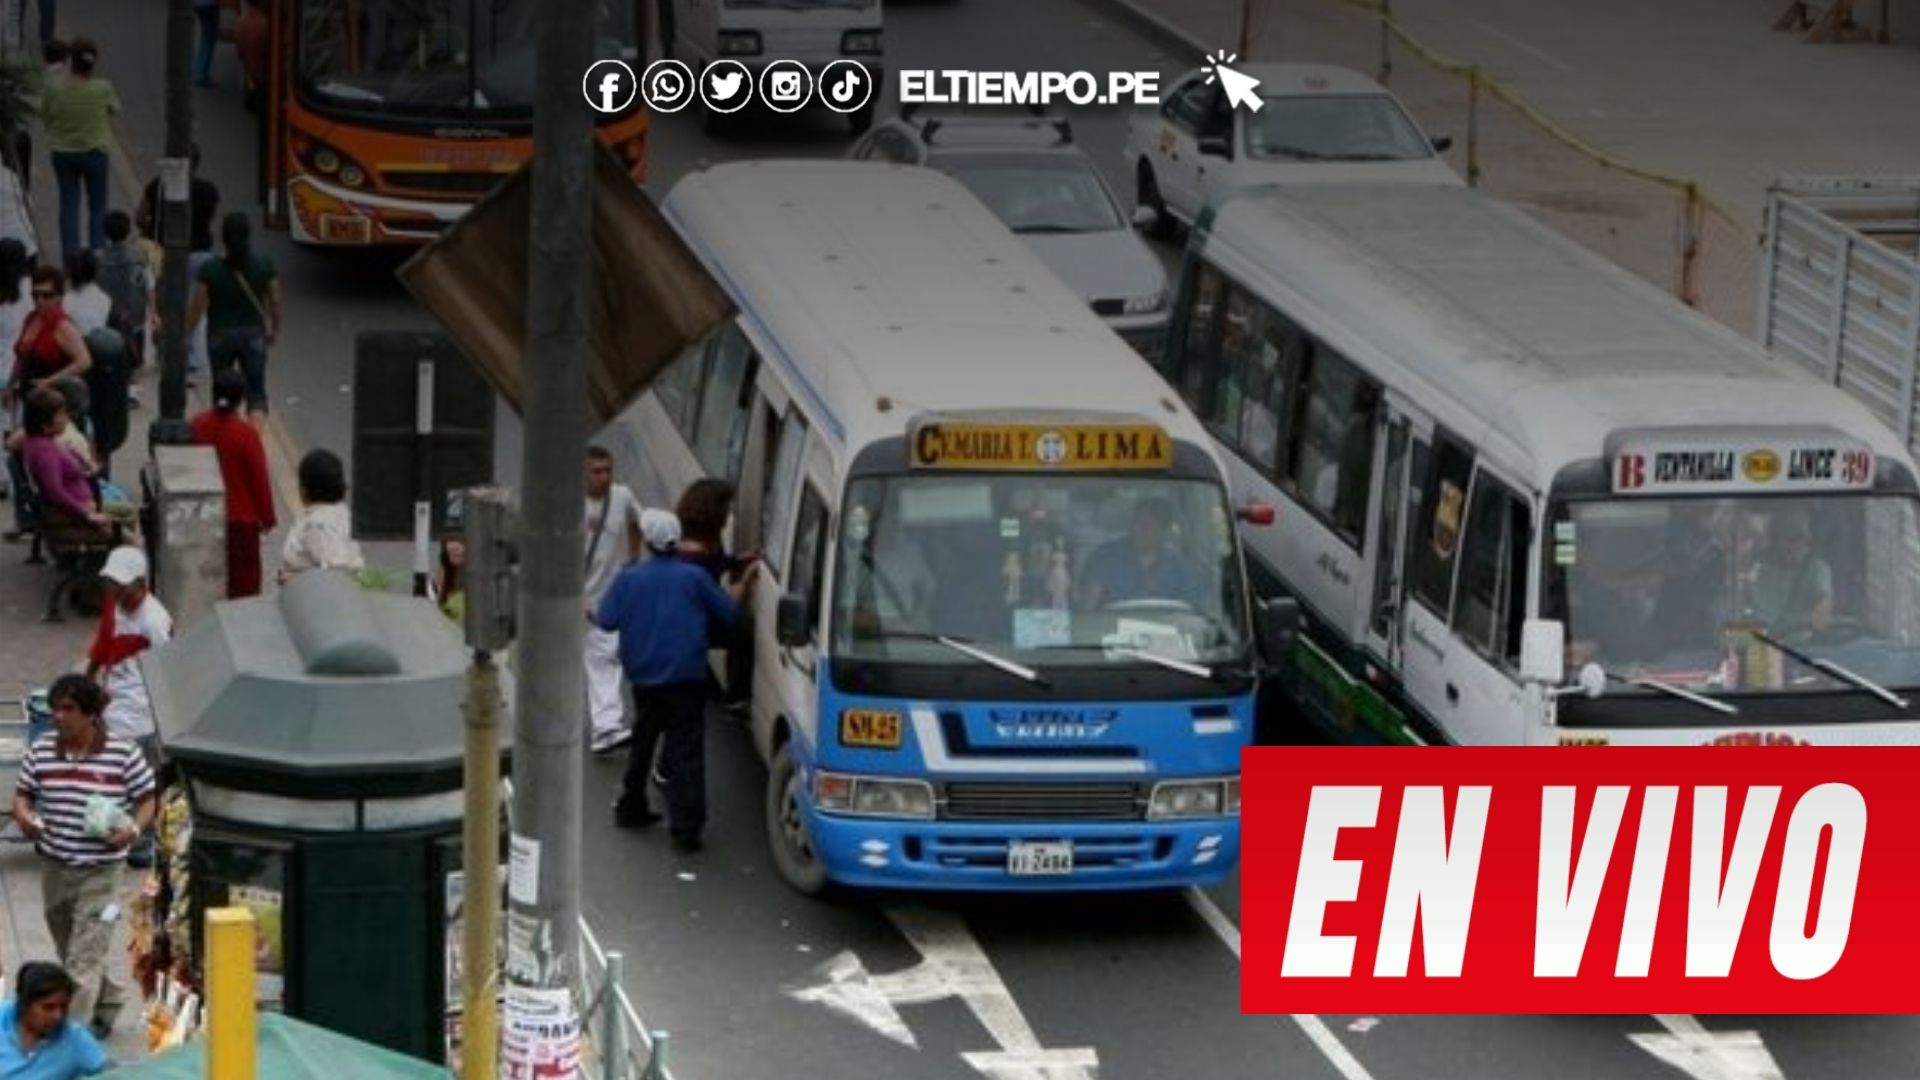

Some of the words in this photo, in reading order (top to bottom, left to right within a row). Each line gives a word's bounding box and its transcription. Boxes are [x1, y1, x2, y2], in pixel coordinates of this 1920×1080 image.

[1075, 432, 1164, 460] LIMA
[1619, 453, 1646, 489] B
[1655, 451, 1734, 483] VENTANILLA
[1787, 448, 1838, 480] LINCE
[1842, 450, 1872, 484] 39
